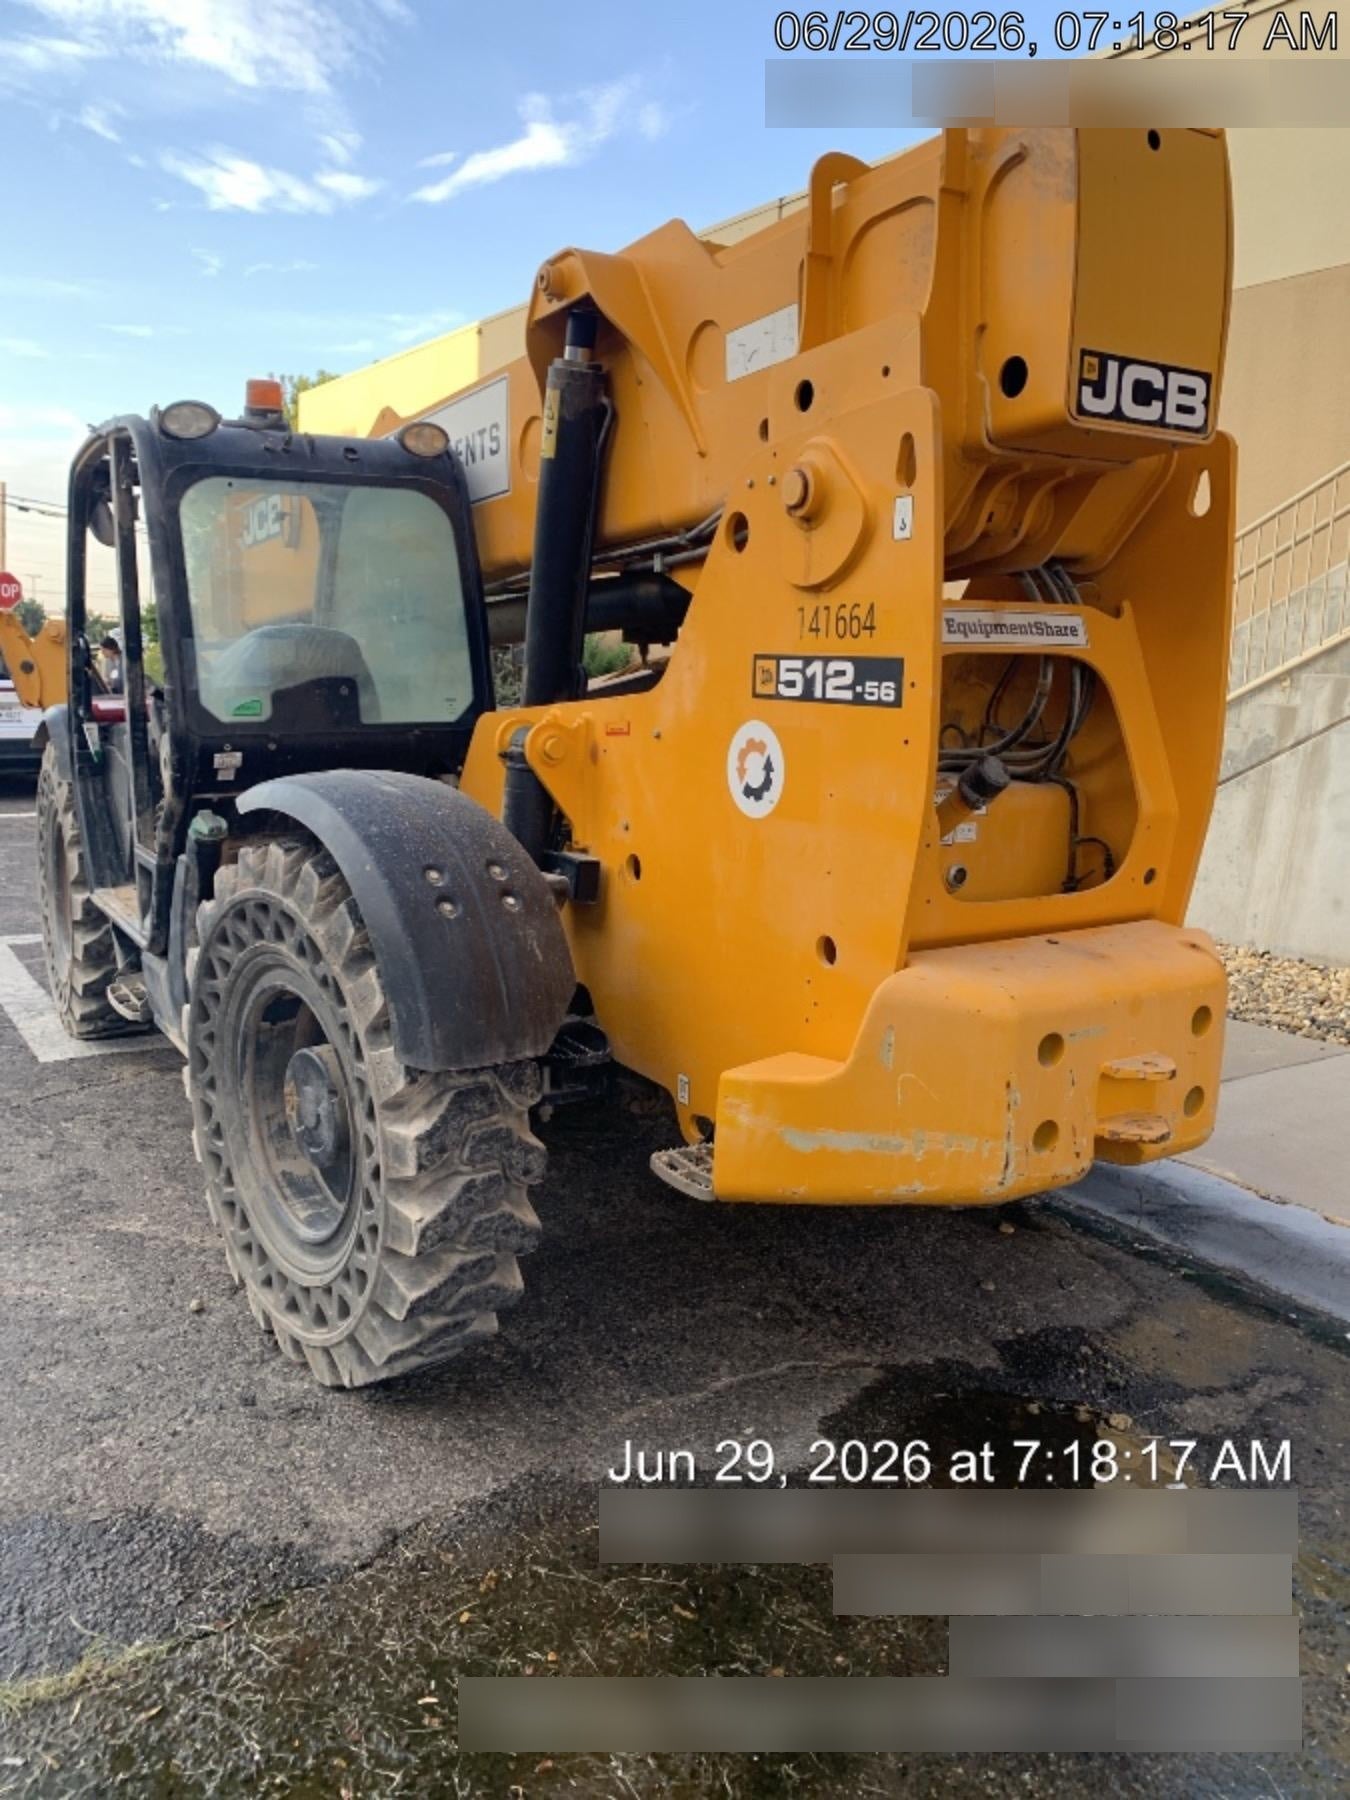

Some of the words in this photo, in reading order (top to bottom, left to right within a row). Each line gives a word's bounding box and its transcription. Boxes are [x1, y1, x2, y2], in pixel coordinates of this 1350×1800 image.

[1081, 360, 1207, 428] JCB
[455, 422, 501, 467] ENTS
[1, 583, 19, 598] OP
[943, 617, 1080, 639] EquipmentShare
